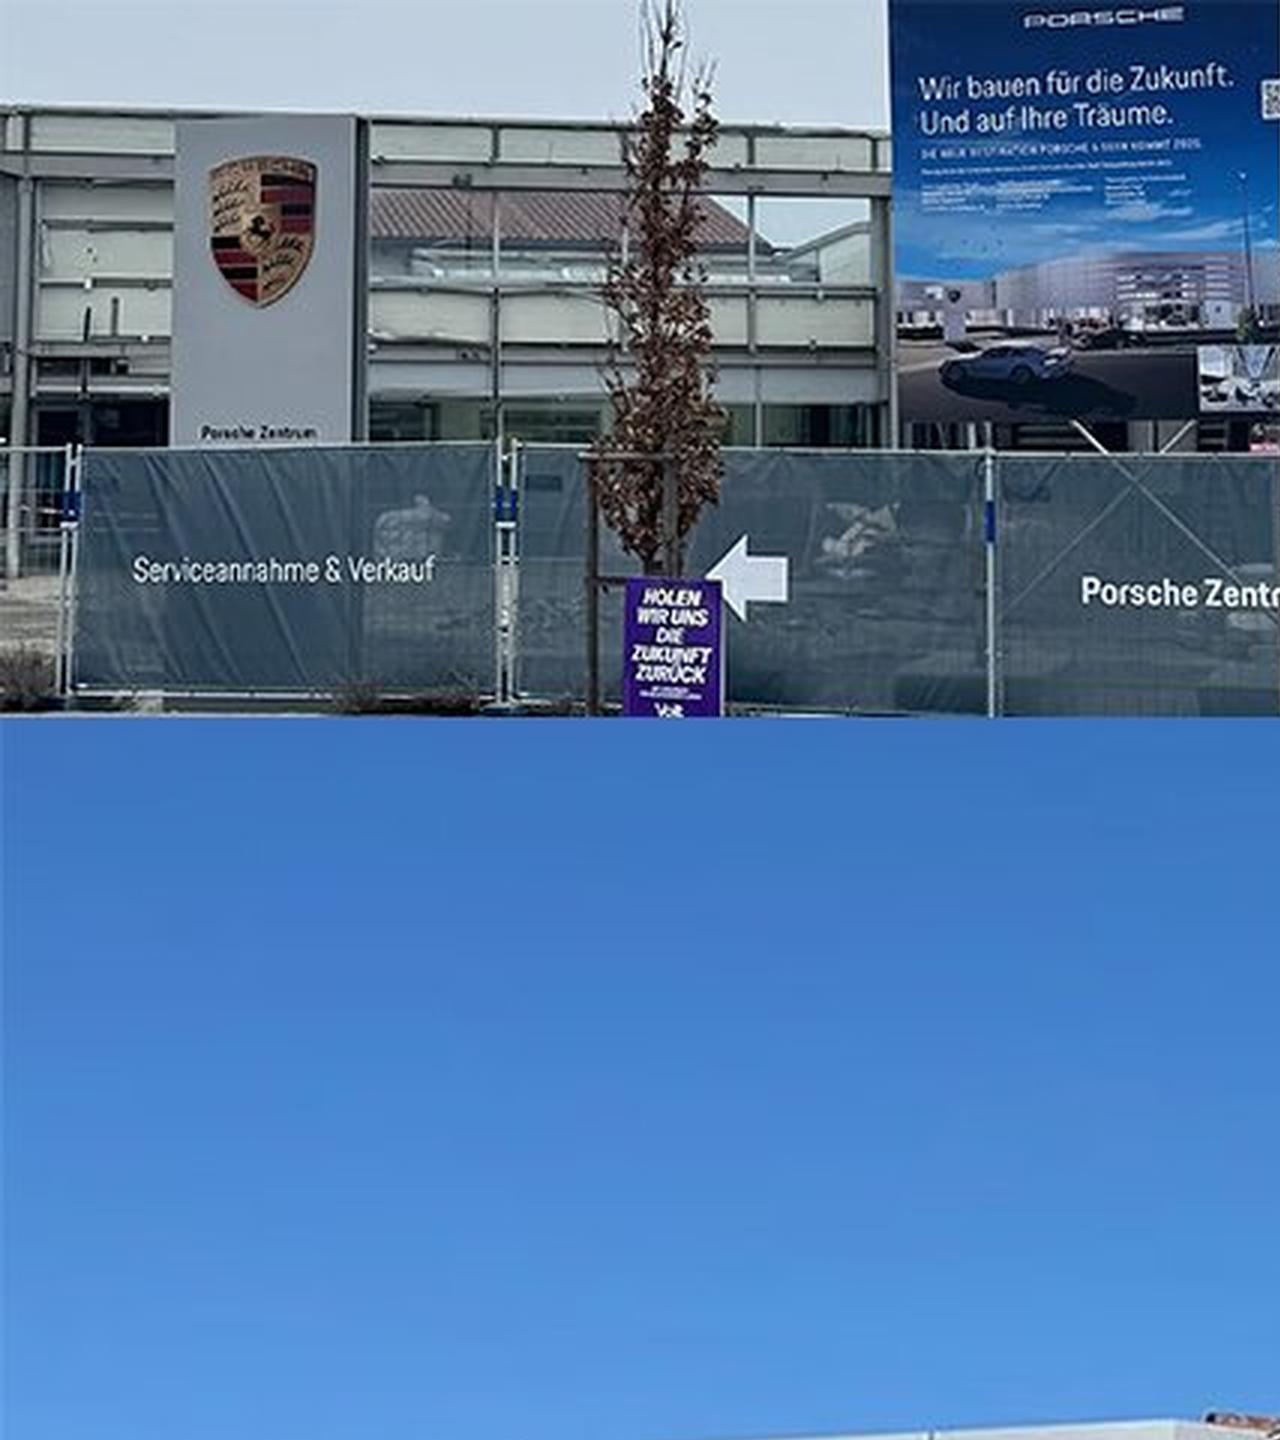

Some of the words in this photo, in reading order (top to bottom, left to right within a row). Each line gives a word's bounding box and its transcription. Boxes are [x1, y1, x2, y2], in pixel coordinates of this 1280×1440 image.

[1024, 6, 1186, 28] PORSCHE
[918, 74, 961, 101] Wir
[967, 74, 1040, 99] bauen
[1047, 68, 1081, 95] für
[1086, 68, 1124, 93] die
[1129, 61, 1235, 91] Zukunft.
[920, 108, 970, 135] Und
[976, 105, 1016, 132] auf
[1021, 106, 1068, 130] Ihre
[1073, 101, 1174, 127] Träume.
[133, 556, 319, 583] Serviceannahme
[324, 555, 341, 583] &
[347, 554, 436, 583] Verkauf
[643, 587, 702, 607] HOLEN
[1081, 576, 1198, 607] Porsche
[637, 607, 670, 624] WIR
[671, 609, 710, 627] UNS
[656, 627, 685, 645] DIE
[631, 645, 713, 664] ZUKUNFT
